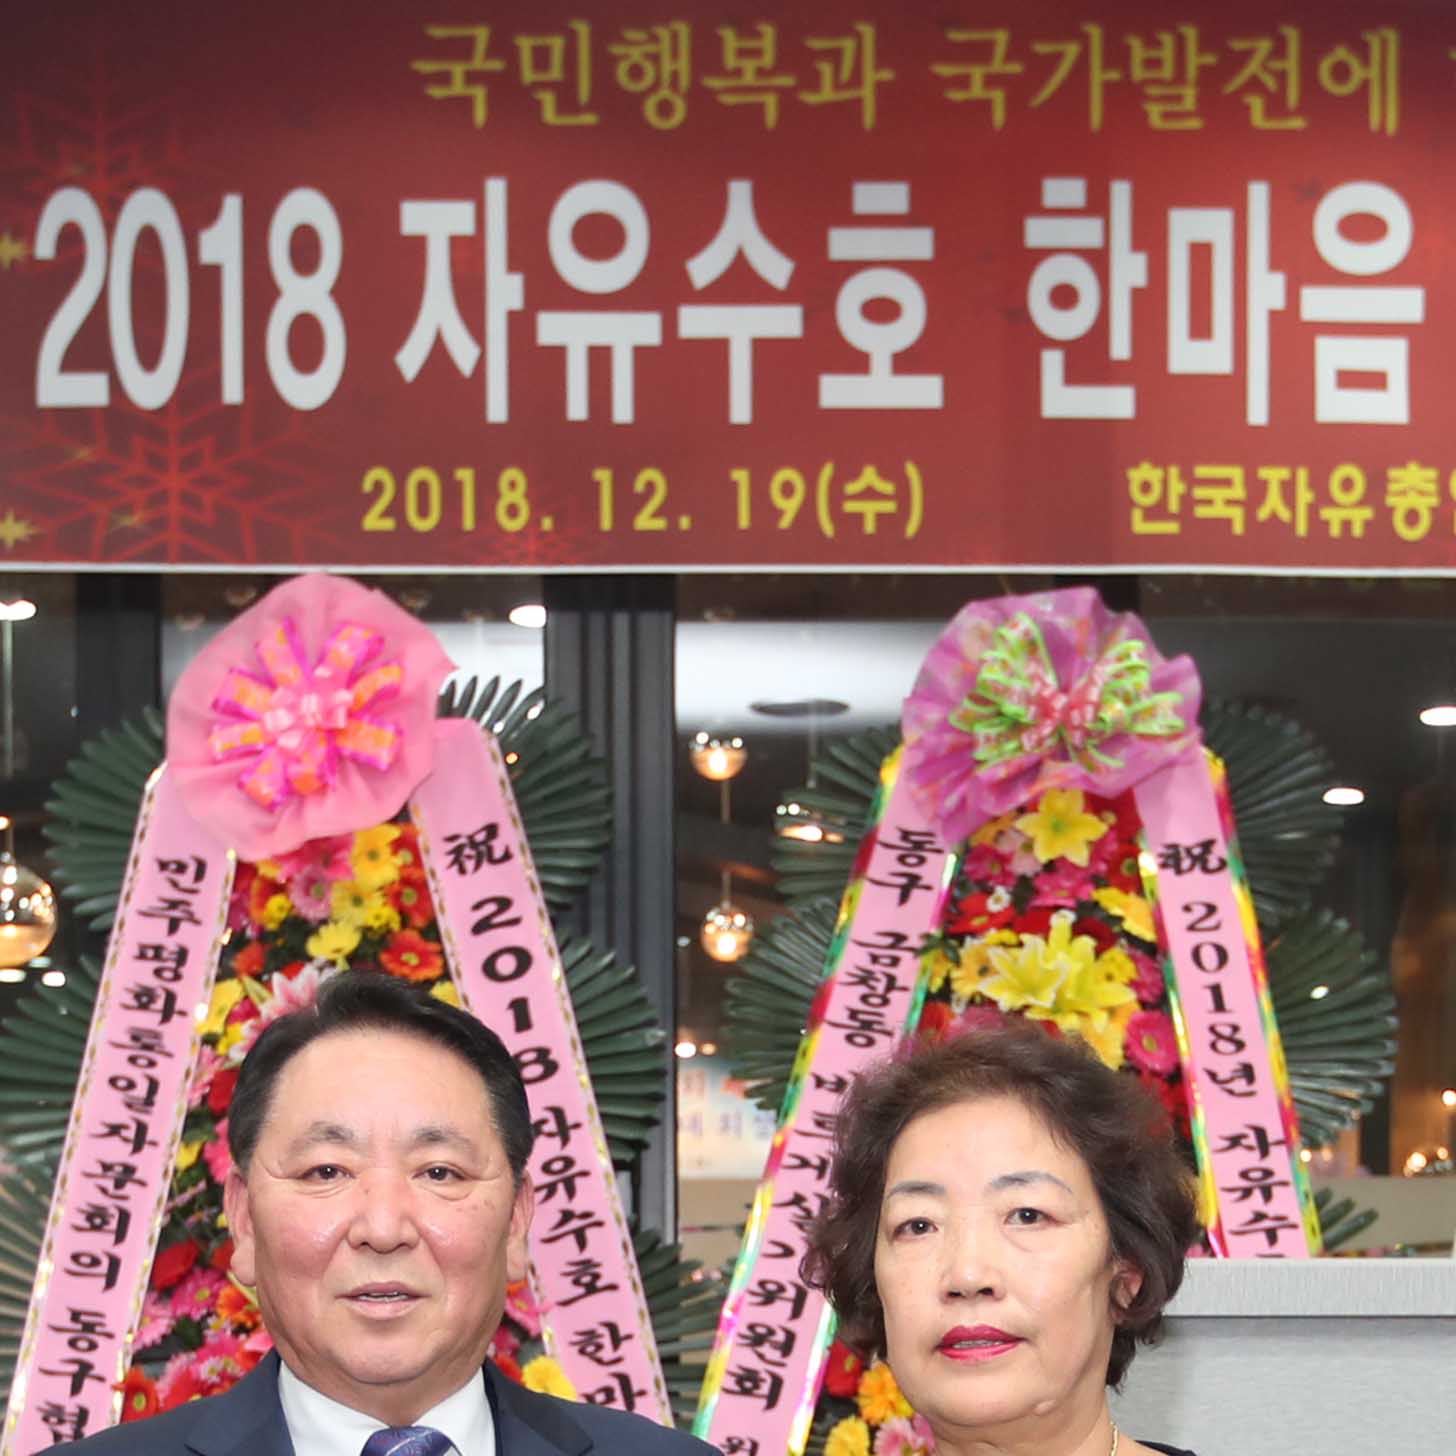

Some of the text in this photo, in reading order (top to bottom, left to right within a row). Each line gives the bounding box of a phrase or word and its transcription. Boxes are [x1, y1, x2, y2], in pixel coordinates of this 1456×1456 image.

[409, 20, 896, 131] 국민행복과
[931, 22, 1399, 138] 국가발전에
[32, 186, 348, 412] 2018
[394, 175, 946, 427] 자유수호
[1023, 174, 1427, 427] 한마음
[361, 460, 924, 539] 2018. 12. 19(수)
[445, 822, 513, 878] 祝
[864, 827, 945, 908] 동구
[470, 895, 560, 1085] 2018
[1157, 838, 1228, 877] 祝
[1213, 1123, 1299, 1258] 자유수
[63, 855, 208, 1293] 민주평화통일자문회의
